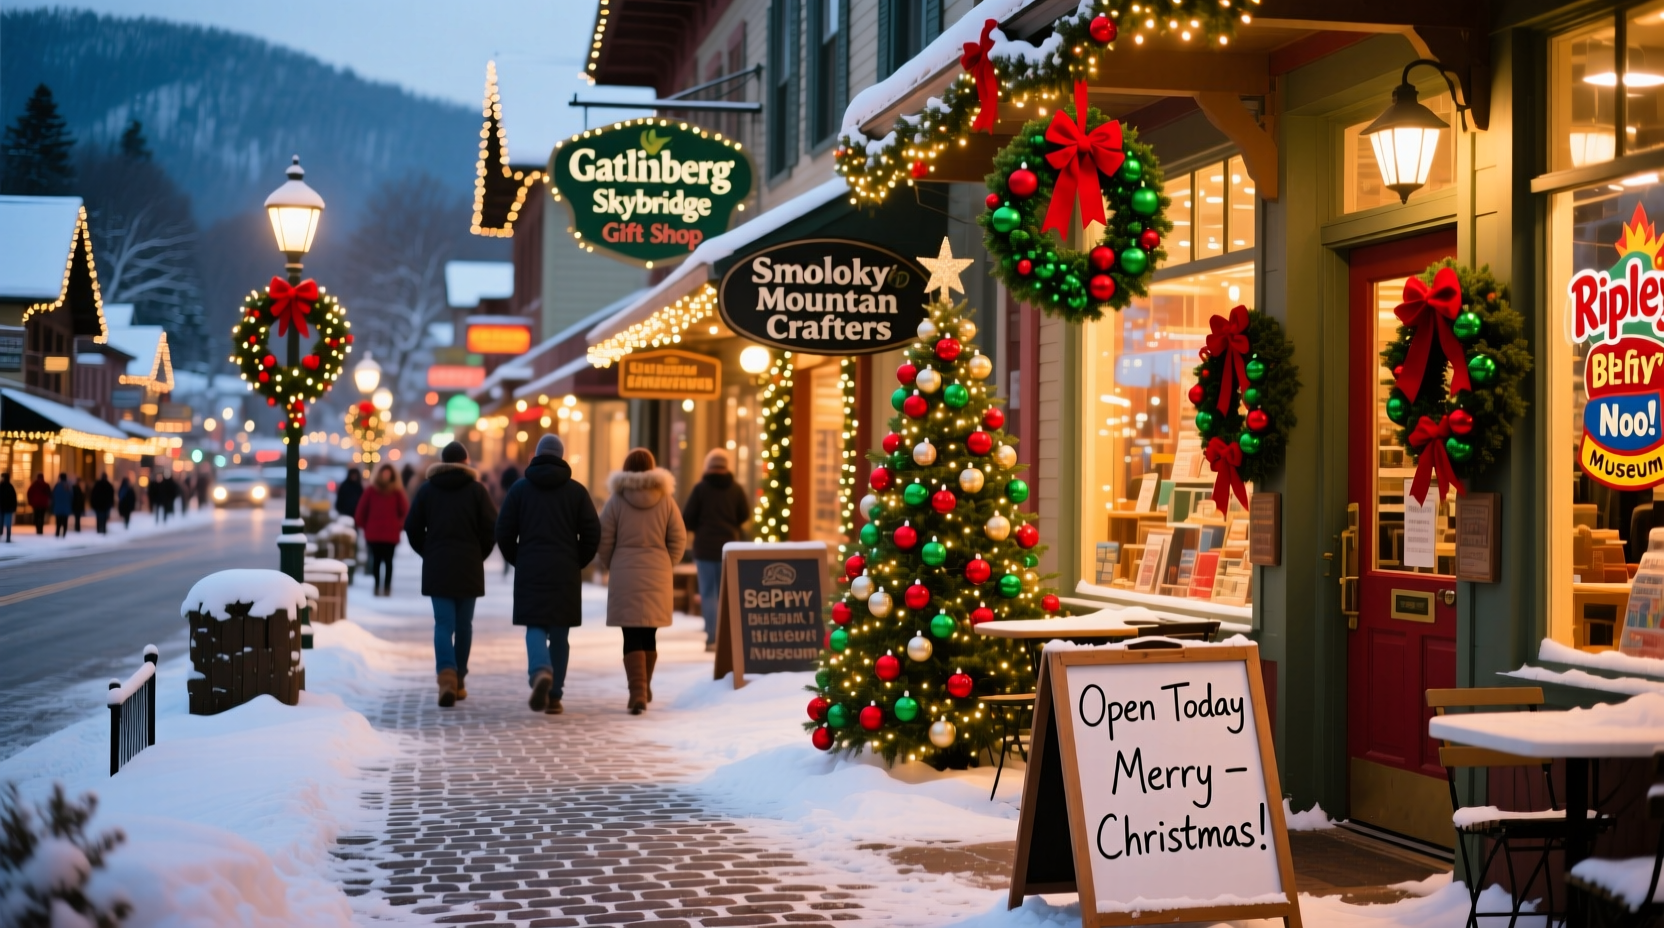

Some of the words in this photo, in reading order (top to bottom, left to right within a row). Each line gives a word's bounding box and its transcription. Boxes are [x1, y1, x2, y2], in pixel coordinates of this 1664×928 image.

[568, 148, 735, 195] Gatlinberg
[592, 188, 712, 223] Skybridge
[602, 222, 644, 243] Gift
[650, 223, 703, 251] Shop
[751, 255, 891, 292] Smoloky
[755, 286, 898, 314] Mountan
[766, 314, 892, 341] Crafters
[1599, 399, 1657, 438] Noo!
[1589, 449, 1663, 479] Museum
[1079, 683, 1156, 741] Open
[1160, 681, 1244, 735] Today
[1111, 747, 1212, 808] Merry
[1096, 802, 1267, 860] Christmas!
